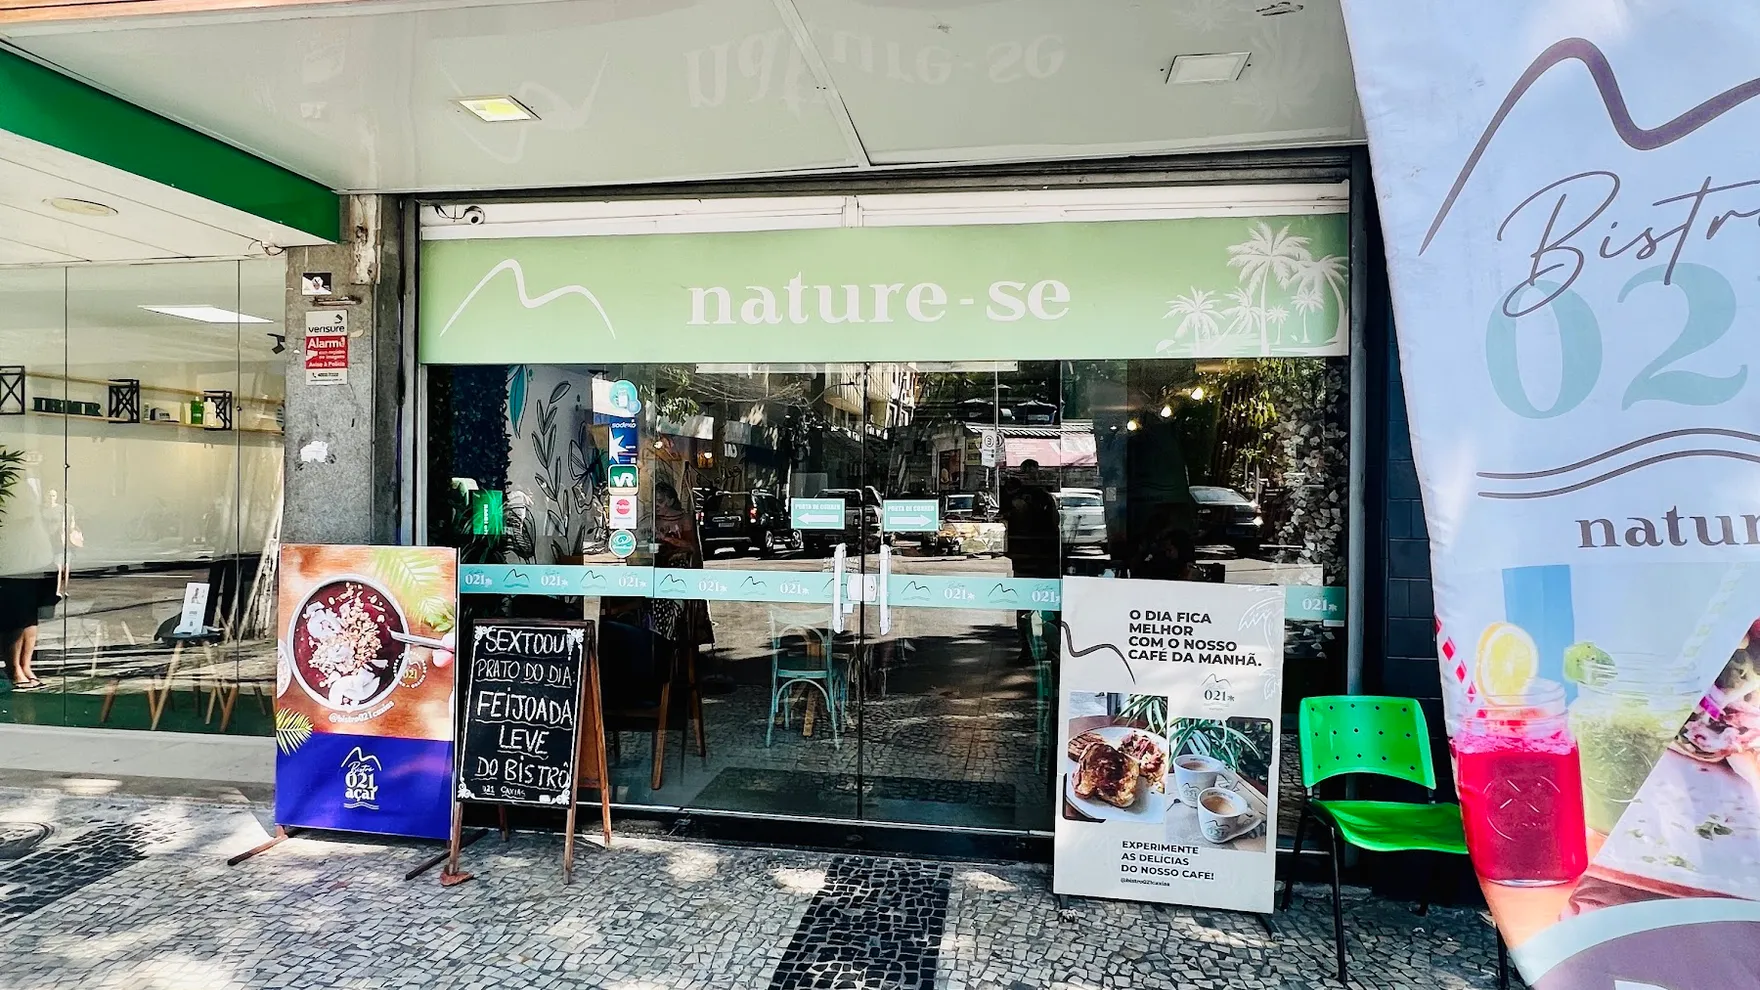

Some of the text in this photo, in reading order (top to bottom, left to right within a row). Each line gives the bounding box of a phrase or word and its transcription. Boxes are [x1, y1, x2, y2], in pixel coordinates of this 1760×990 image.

[1498, 171, 1760, 317] Bistr
[308, 325, 345, 333] verisure
[1486, 262, 1760, 419] 02
[611, 421, 637, 429] sodexo
[465, 574, 486, 586] 021
[541, 575, 562, 587] 021
[619, 576, 639, 588] 021
[699, 580, 720, 592] 021
[780, 582, 801, 594] 021
[944, 588, 967, 600] 021
[1032, 591, 1056, 603] 021
[1302, 598, 1328, 611] 021
[1129, 610, 1212, 624] O DIA FICA
[1129, 623, 1194, 636] MELHOR
[1128, 636, 1238, 652] COM O NOSSO
[1128, 647, 1262, 667] CAFÉ DA MANHÃ.
[475, 659, 521, 679] PRATO
[524, 662, 544, 682] DO
[1204, 690, 1227, 702] 021
[477, 686, 573, 726] FEIJOADA
[499, 725, 549, 754] LEVE
[474, 756, 499, 777] DO
[345, 771, 374, 789] 021
[1122, 840, 1199, 854] EXPERIMENTE
[1121, 852, 1189, 866] AS DELÍCIAS
[1121, 864, 1138, 873] DO
[1141, 866, 1179, 877] NOSSO
